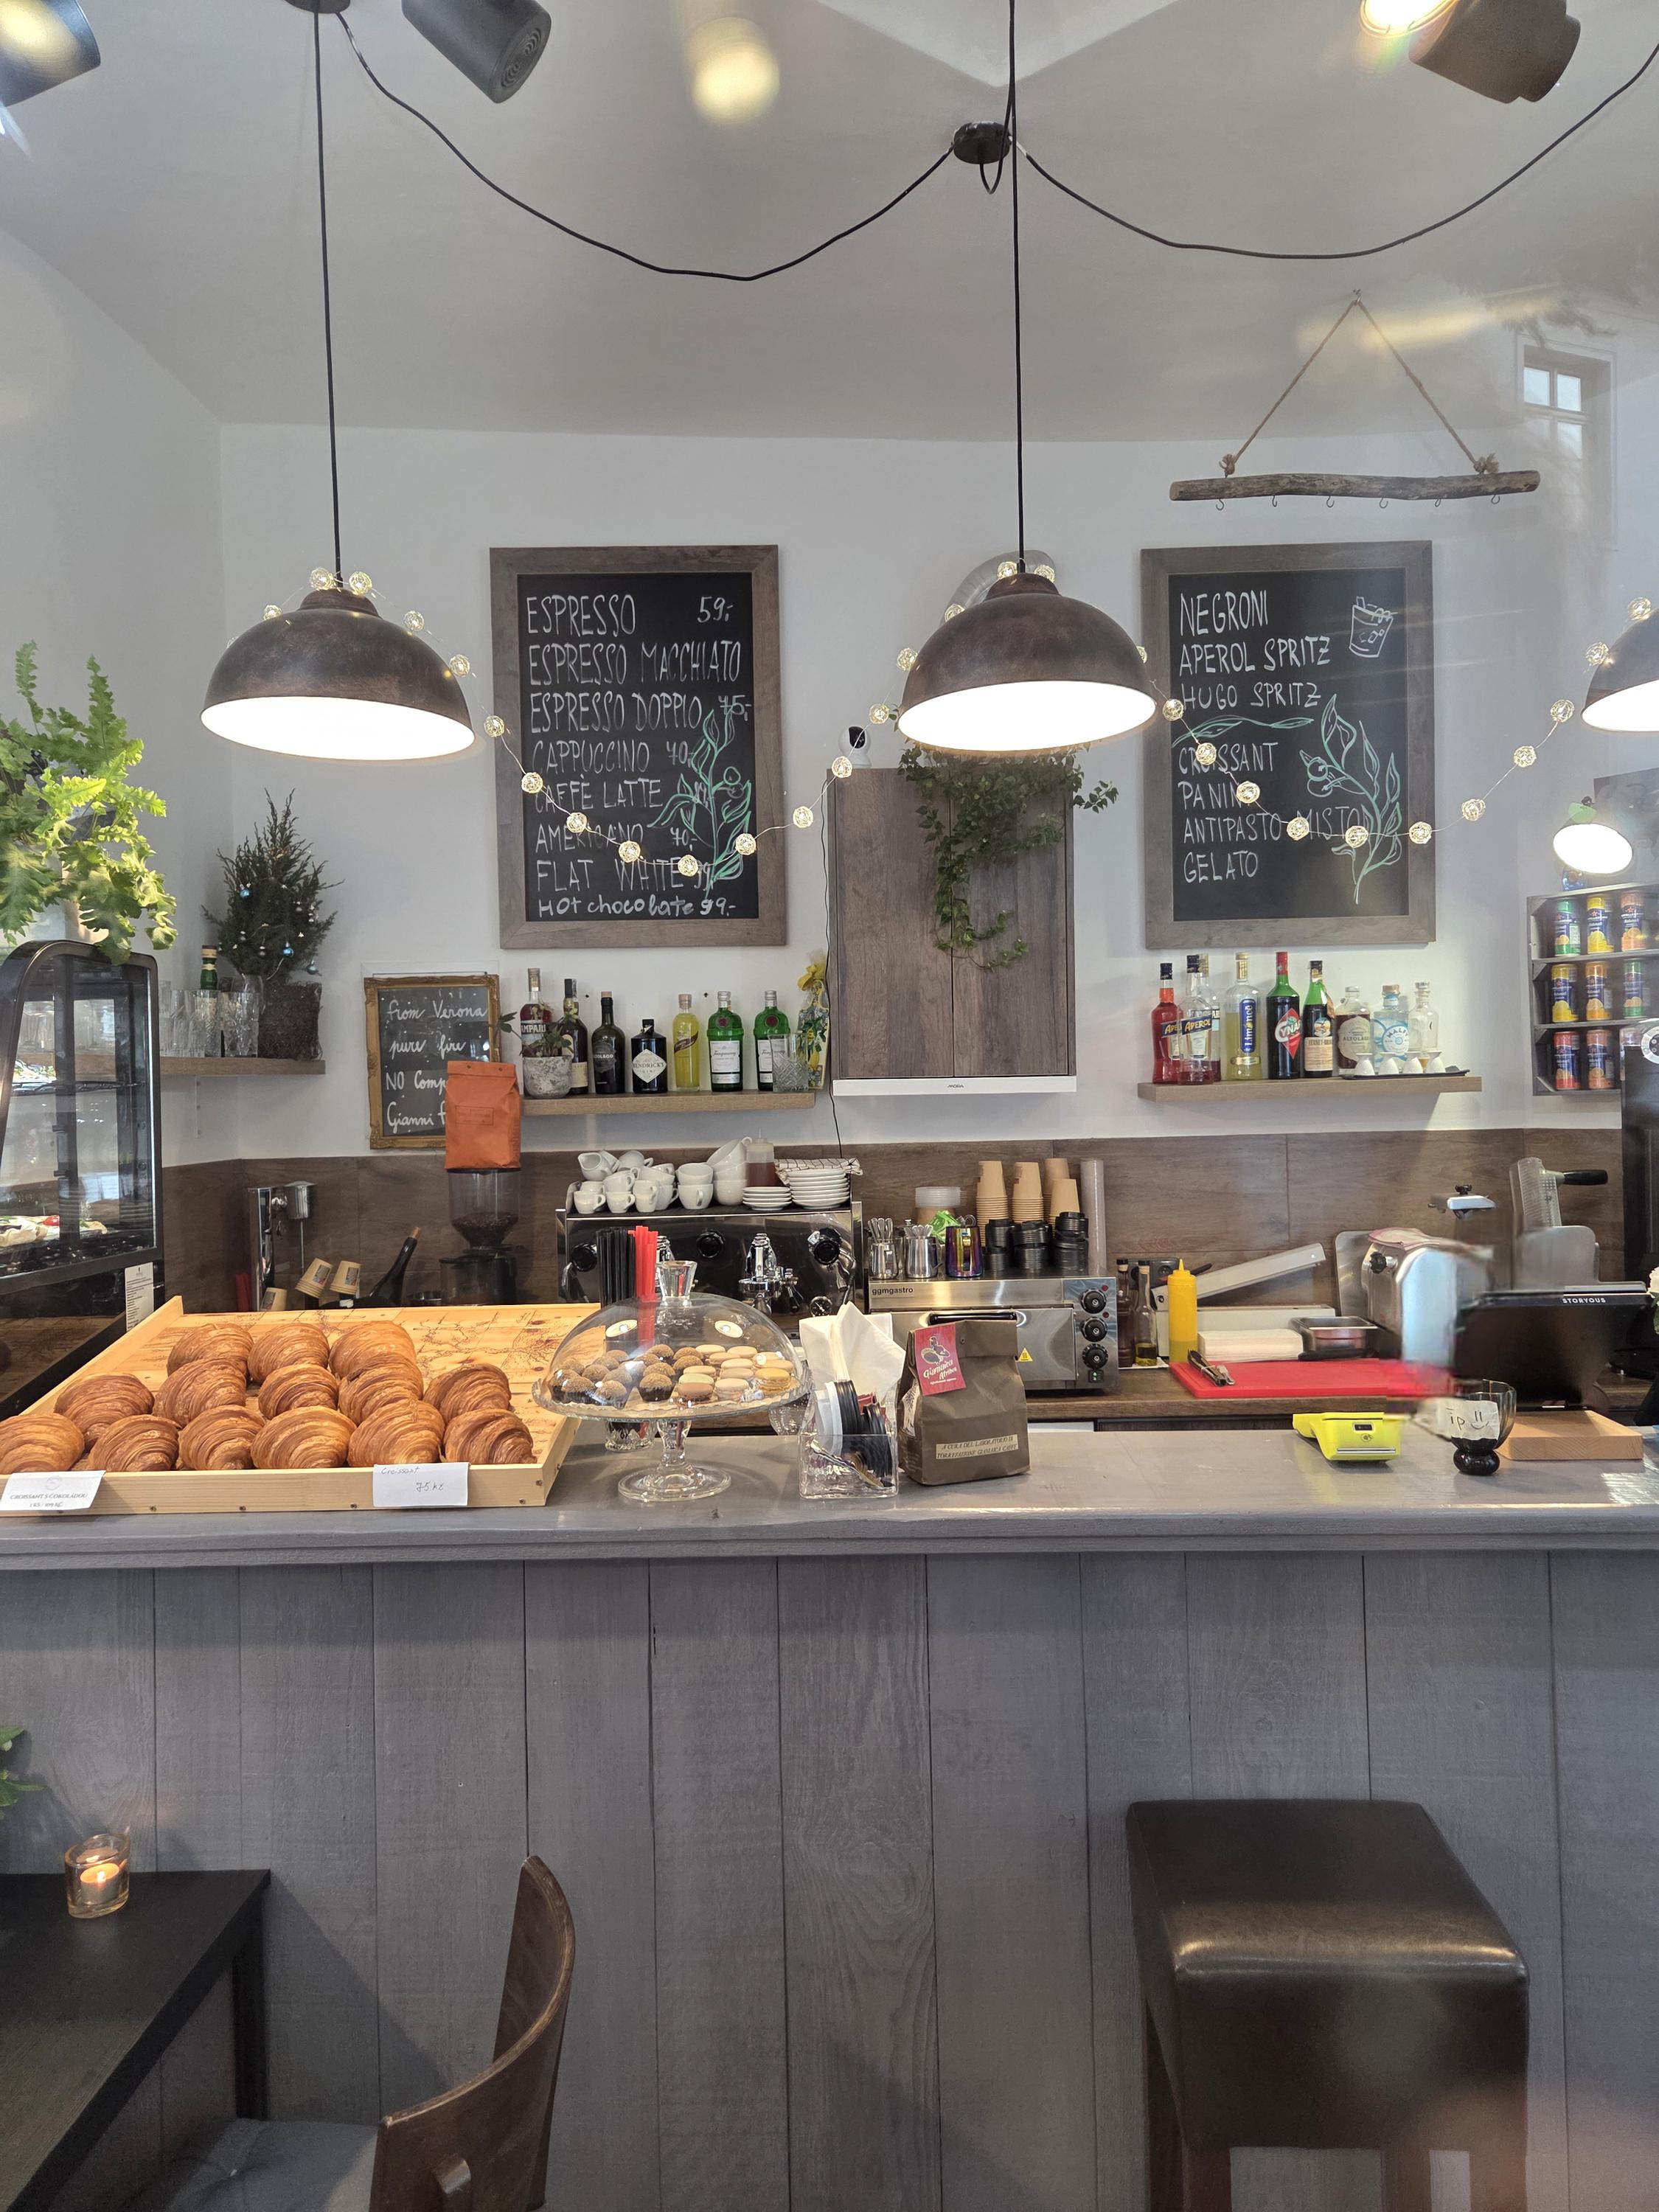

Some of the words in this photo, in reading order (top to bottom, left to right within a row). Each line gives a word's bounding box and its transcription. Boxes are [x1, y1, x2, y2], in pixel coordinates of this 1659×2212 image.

[526, 594, 636, 636] ESPRESSO
[1180, 590, 1268, 636] NEGRONI
[529, 643, 627, 686] ESPRESSO
[640, 639, 742, 684] MACCHIATO
[1180, 641, 1255, 677] APEROL
[1264, 636, 1330, 671] SPRITZ
[1181, 683, 1237, 710] HUGO
[1251, 681, 1321, 708] SPRITZ
[530, 690, 625, 734] ESPRESSO
[632, 692, 702, 732] DOPPIO
[532, 740, 650, 776] CAPPUCCINO
[1180, 742, 1278, 774] CRSSANT
[603, 777, 663, 808] LATTE
[1183, 813, 1282, 844] ANTIPASTO
[537, 860, 594, 891] FLAT
[614, 856, 684, 891] WHITE
[1184, 850, 1258, 883] GELATO
[588, 894, 695, 917] chocolate
[433, 999, 488, 1018] Verona
[389, 1040, 426, 1060] pure
[438, 1034, 466, 1060] fire
[387, 1101, 434, 1133] Gianni
[872, 1286, 914, 1295] ggmgastro
[1446, 1407, 1465, 1430] ip
